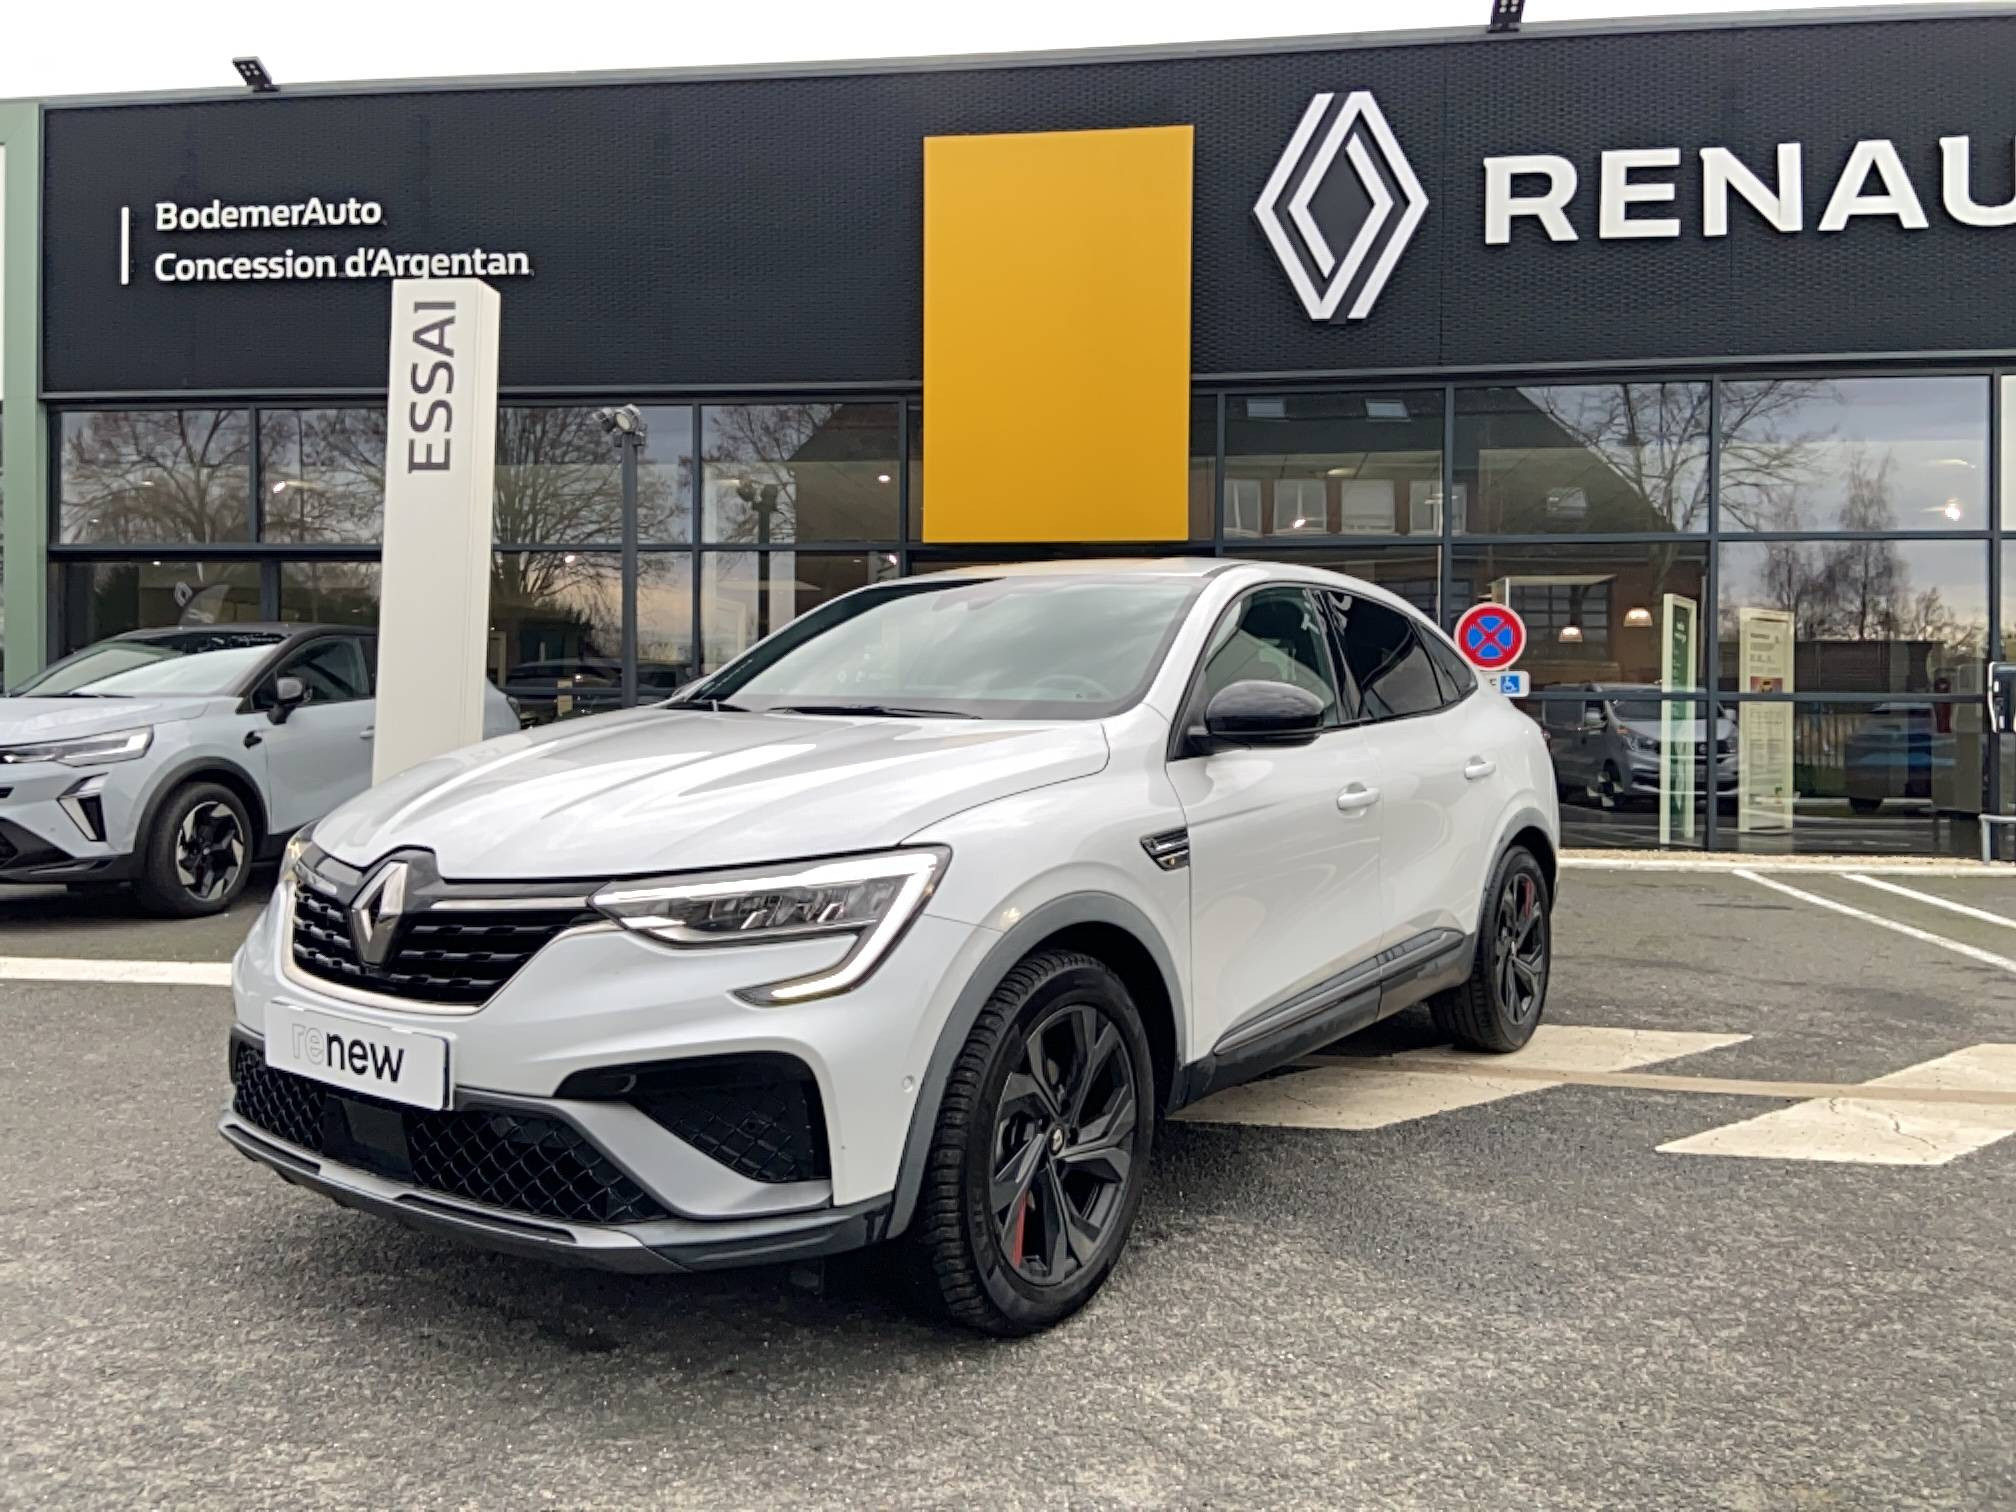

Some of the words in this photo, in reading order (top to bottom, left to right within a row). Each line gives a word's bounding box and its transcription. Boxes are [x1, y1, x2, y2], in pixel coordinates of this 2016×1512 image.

[155, 197, 382, 231] BodemerAuto
[1483, 135, 2016, 244] RENAU
[155, 249, 337, 281] Concession
[345, 247, 530, 279] d'Argentan
[407, 300, 456, 474] ESSAI
[292, 1023, 404, 1083] renew
